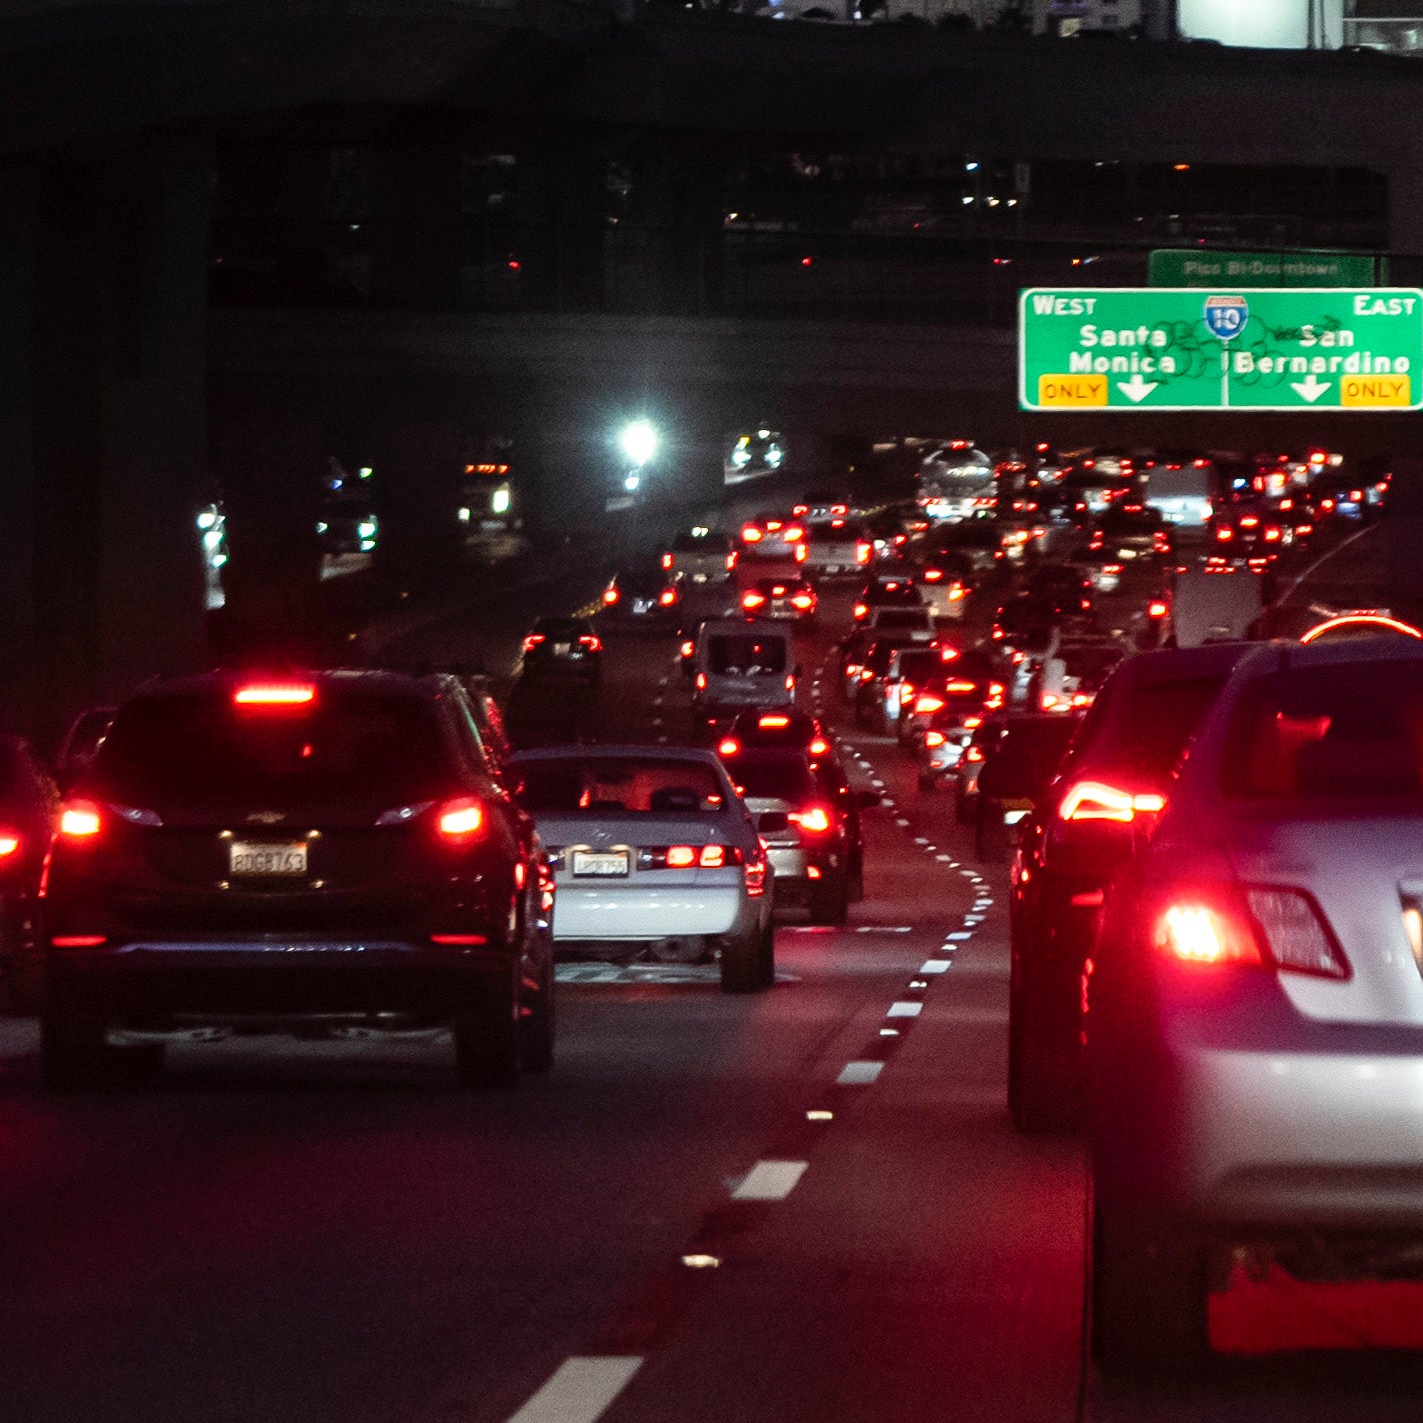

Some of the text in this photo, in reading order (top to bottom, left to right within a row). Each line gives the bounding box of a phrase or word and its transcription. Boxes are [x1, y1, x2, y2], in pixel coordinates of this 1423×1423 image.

[1032, 294, 1098, 316] WEST
[1353, 294, 1417, 316] EAST
[1212, 308, 1240, 330] 10
[1079, 324, 1167, 348] Santa
[1299, 324, 1355, 348] San
[1068, 351, 1176, 374] Monica
[1233, 351, 1411, 374] Bernardino
[1043, 383, 1103, 400] ONLY
[1346, 381, 1404, 398] ONLY
